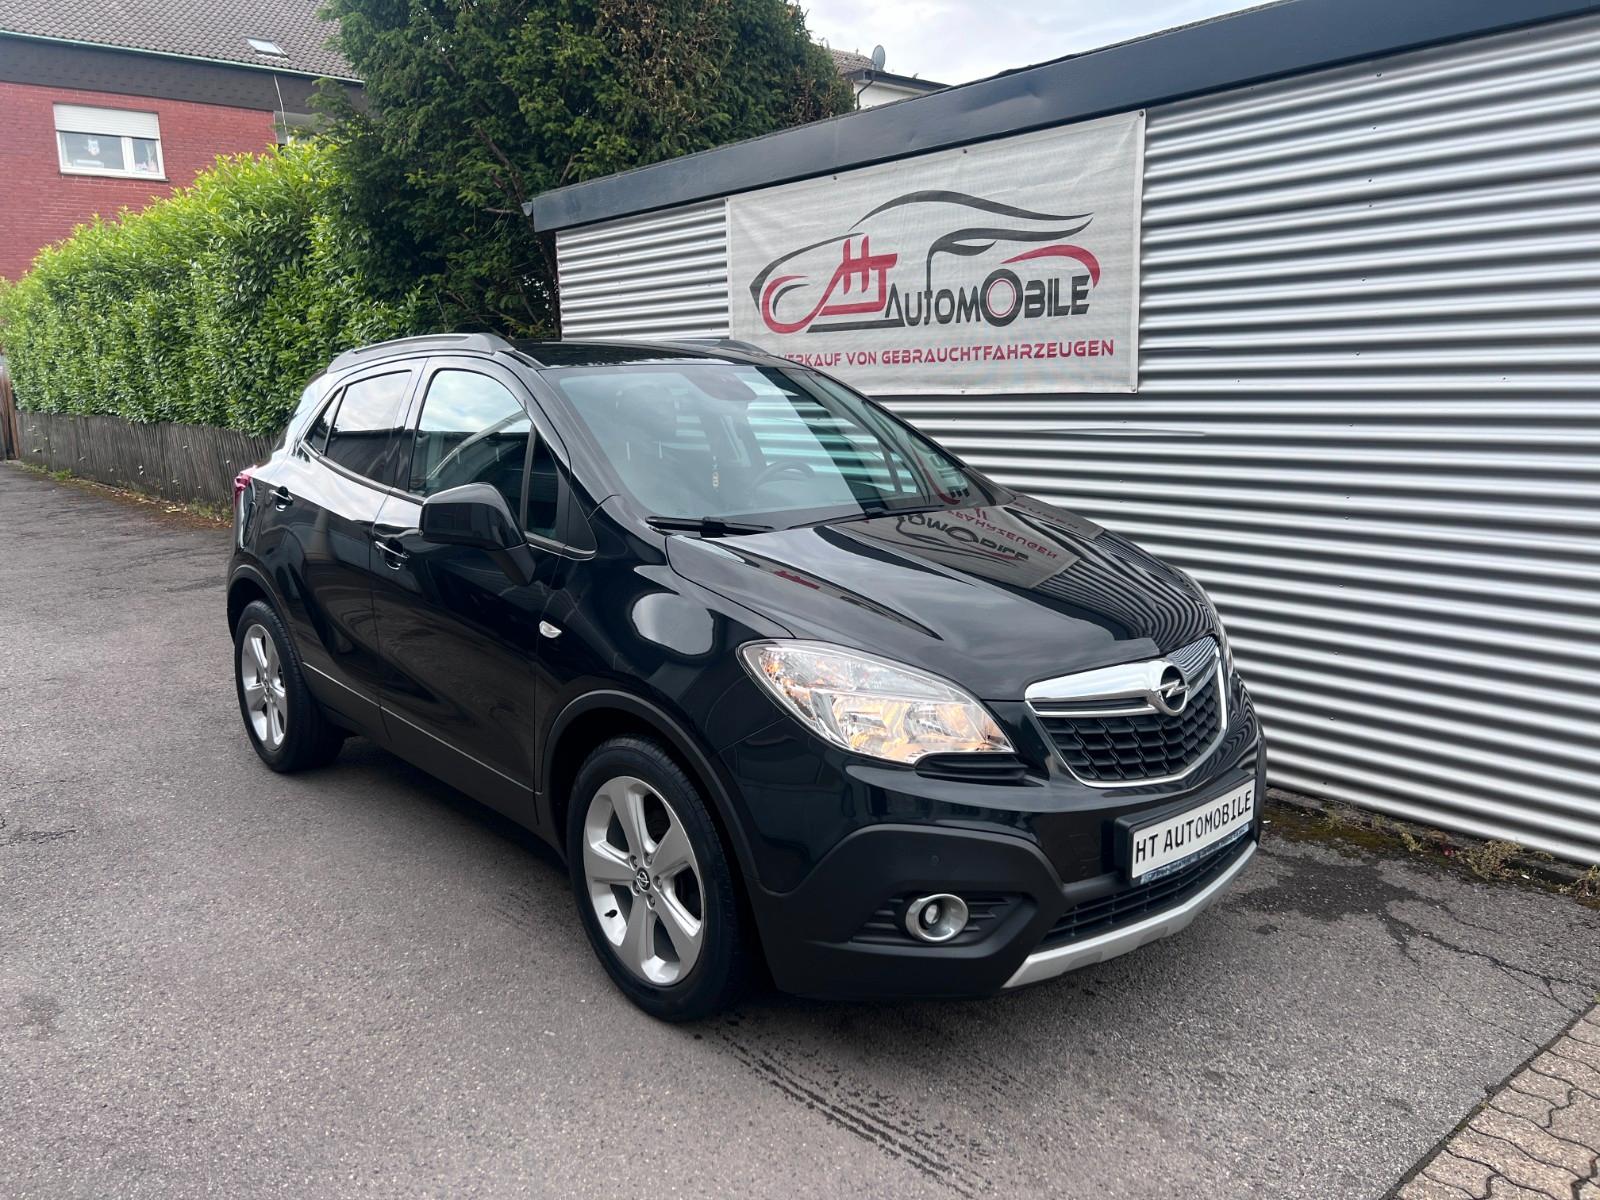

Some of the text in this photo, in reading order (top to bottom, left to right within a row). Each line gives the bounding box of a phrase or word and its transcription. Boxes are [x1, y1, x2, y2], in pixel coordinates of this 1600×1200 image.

[884, 268, 1090, 327] AUTOMOBILE
[845, 351, 877, 366] VON
[881, 339, 1114, 365] GEBRAUCHTFAHRZEUGEN
[1135, 833, 1158, 865] HT
[1163, 790, 1252, 853] AUTOMOBILE
